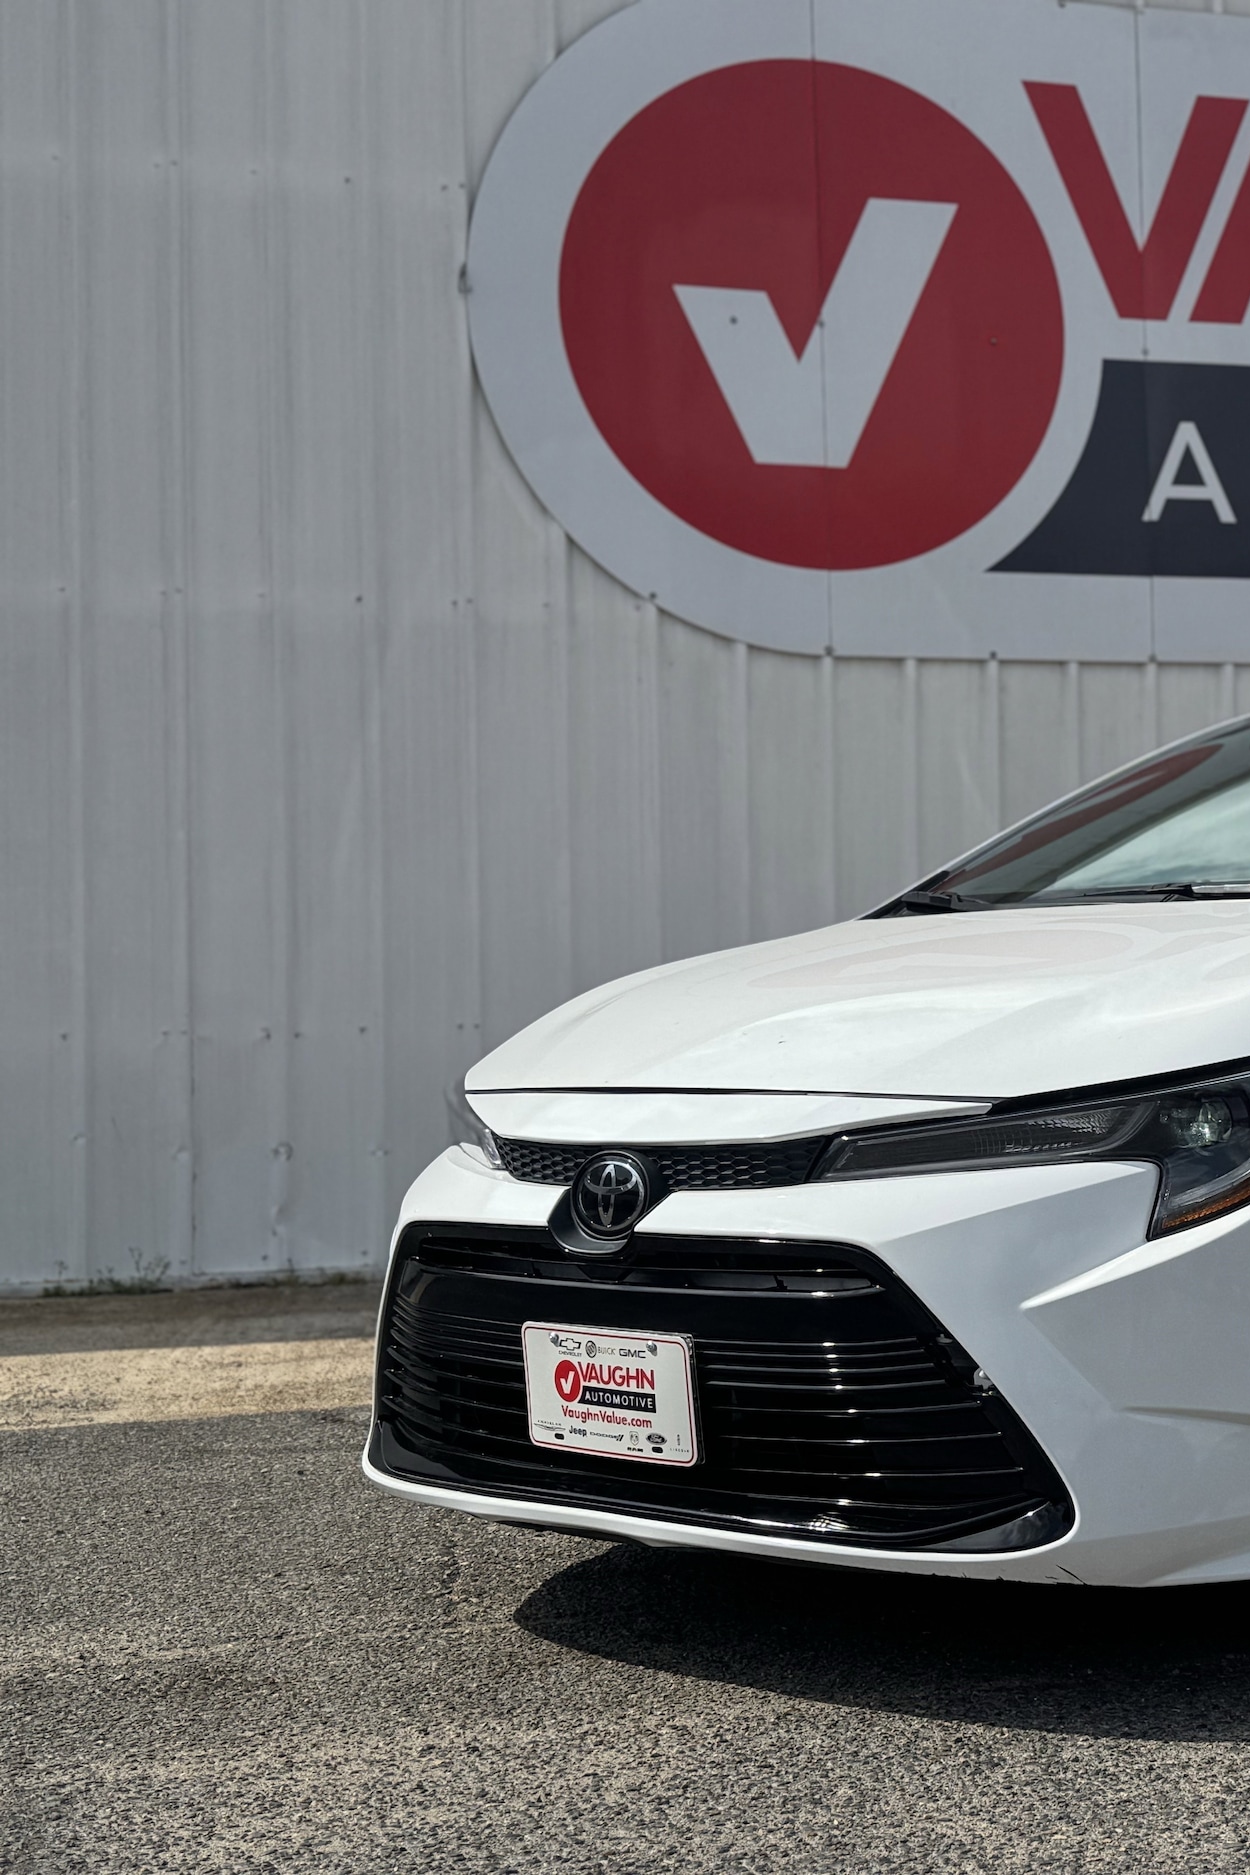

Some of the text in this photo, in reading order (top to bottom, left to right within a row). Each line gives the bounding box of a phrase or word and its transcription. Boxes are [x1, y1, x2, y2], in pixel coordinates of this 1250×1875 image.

[597, 1346, 646, 1359] BUICK GMC
[577, 1361, 655, 1391] VAUGHN
[585, 1392, 654, 1409] AUTOMOTIVE
[561, 1405, 653, 1429] VaughnValue.com
[568, 1425, 588, 1437] Jeep
